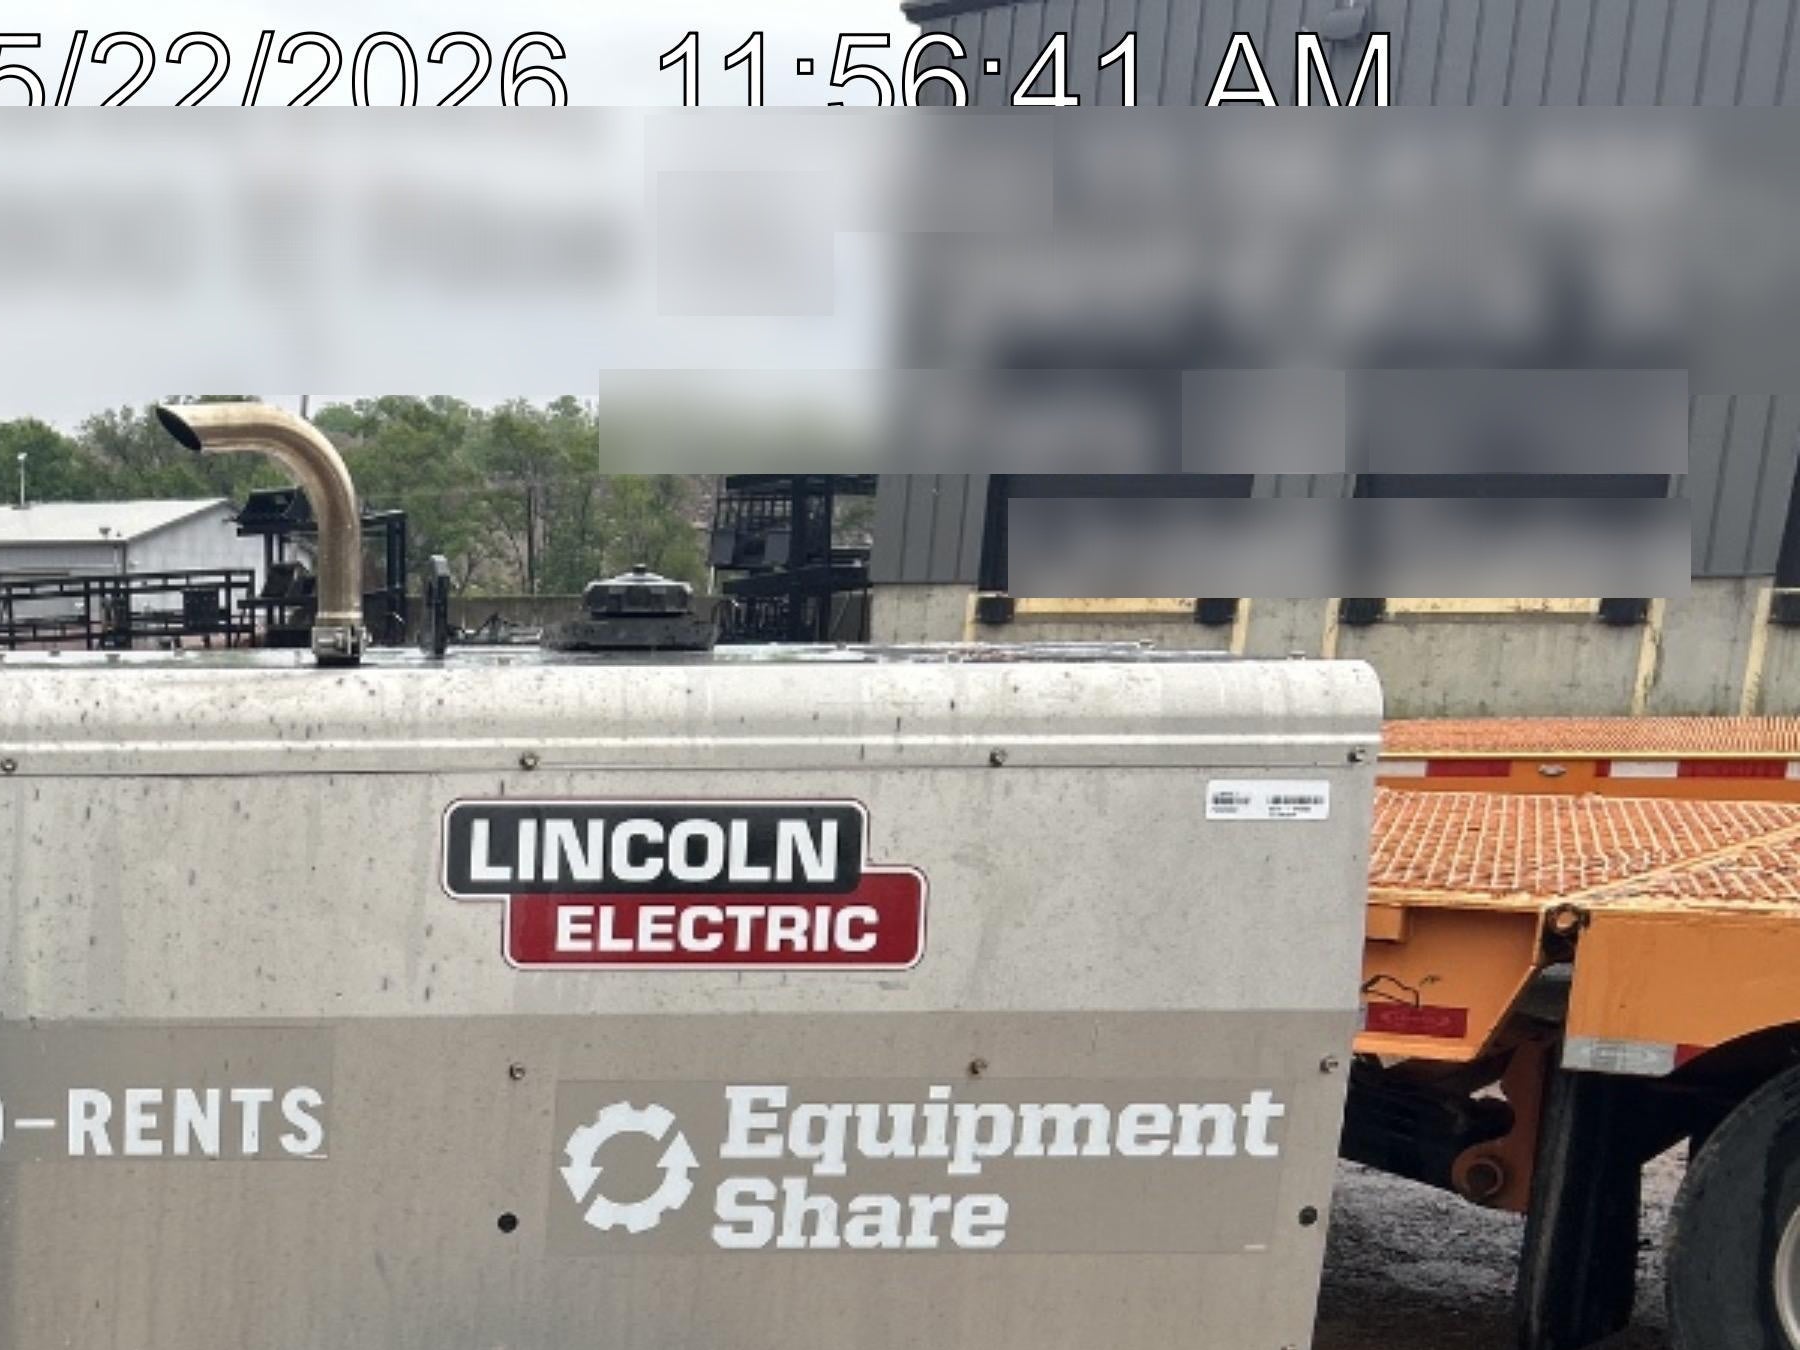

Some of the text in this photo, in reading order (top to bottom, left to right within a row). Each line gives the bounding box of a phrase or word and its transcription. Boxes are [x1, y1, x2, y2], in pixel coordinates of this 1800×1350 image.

[470, 818, 839, 883] LINCOLN
[555, 905, 880, 953] ELECTRIC
[719, 1085, 1286, 1176] Equipment
[712, 1177, 1010, 1248] Share
